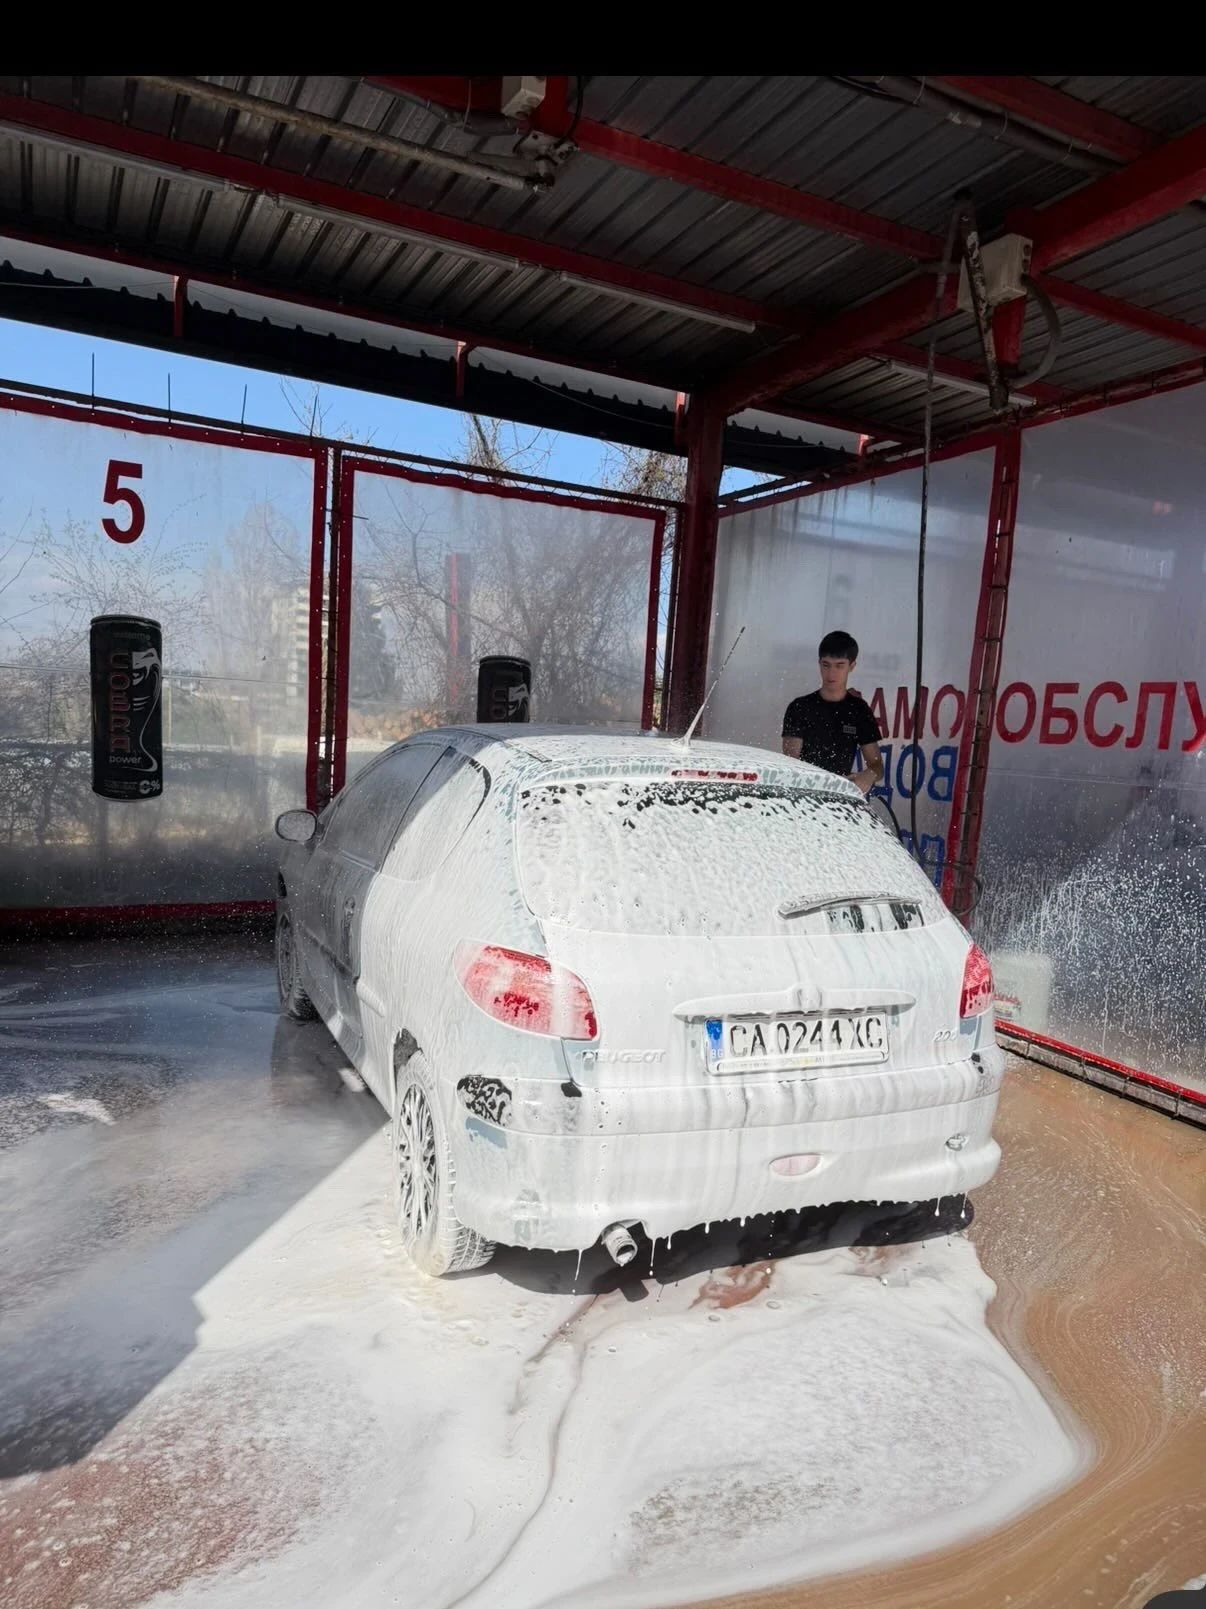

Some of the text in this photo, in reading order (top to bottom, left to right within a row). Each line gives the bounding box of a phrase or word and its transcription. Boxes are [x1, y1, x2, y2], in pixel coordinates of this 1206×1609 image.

[102, 459, 146, 544] 5
[109, 756, 142, 764] power
[729, 1023, 768, 1058] CA
[849, 1016, 883, 1050] XC
[581, 1048, 667, 1064] PEUGEOT
